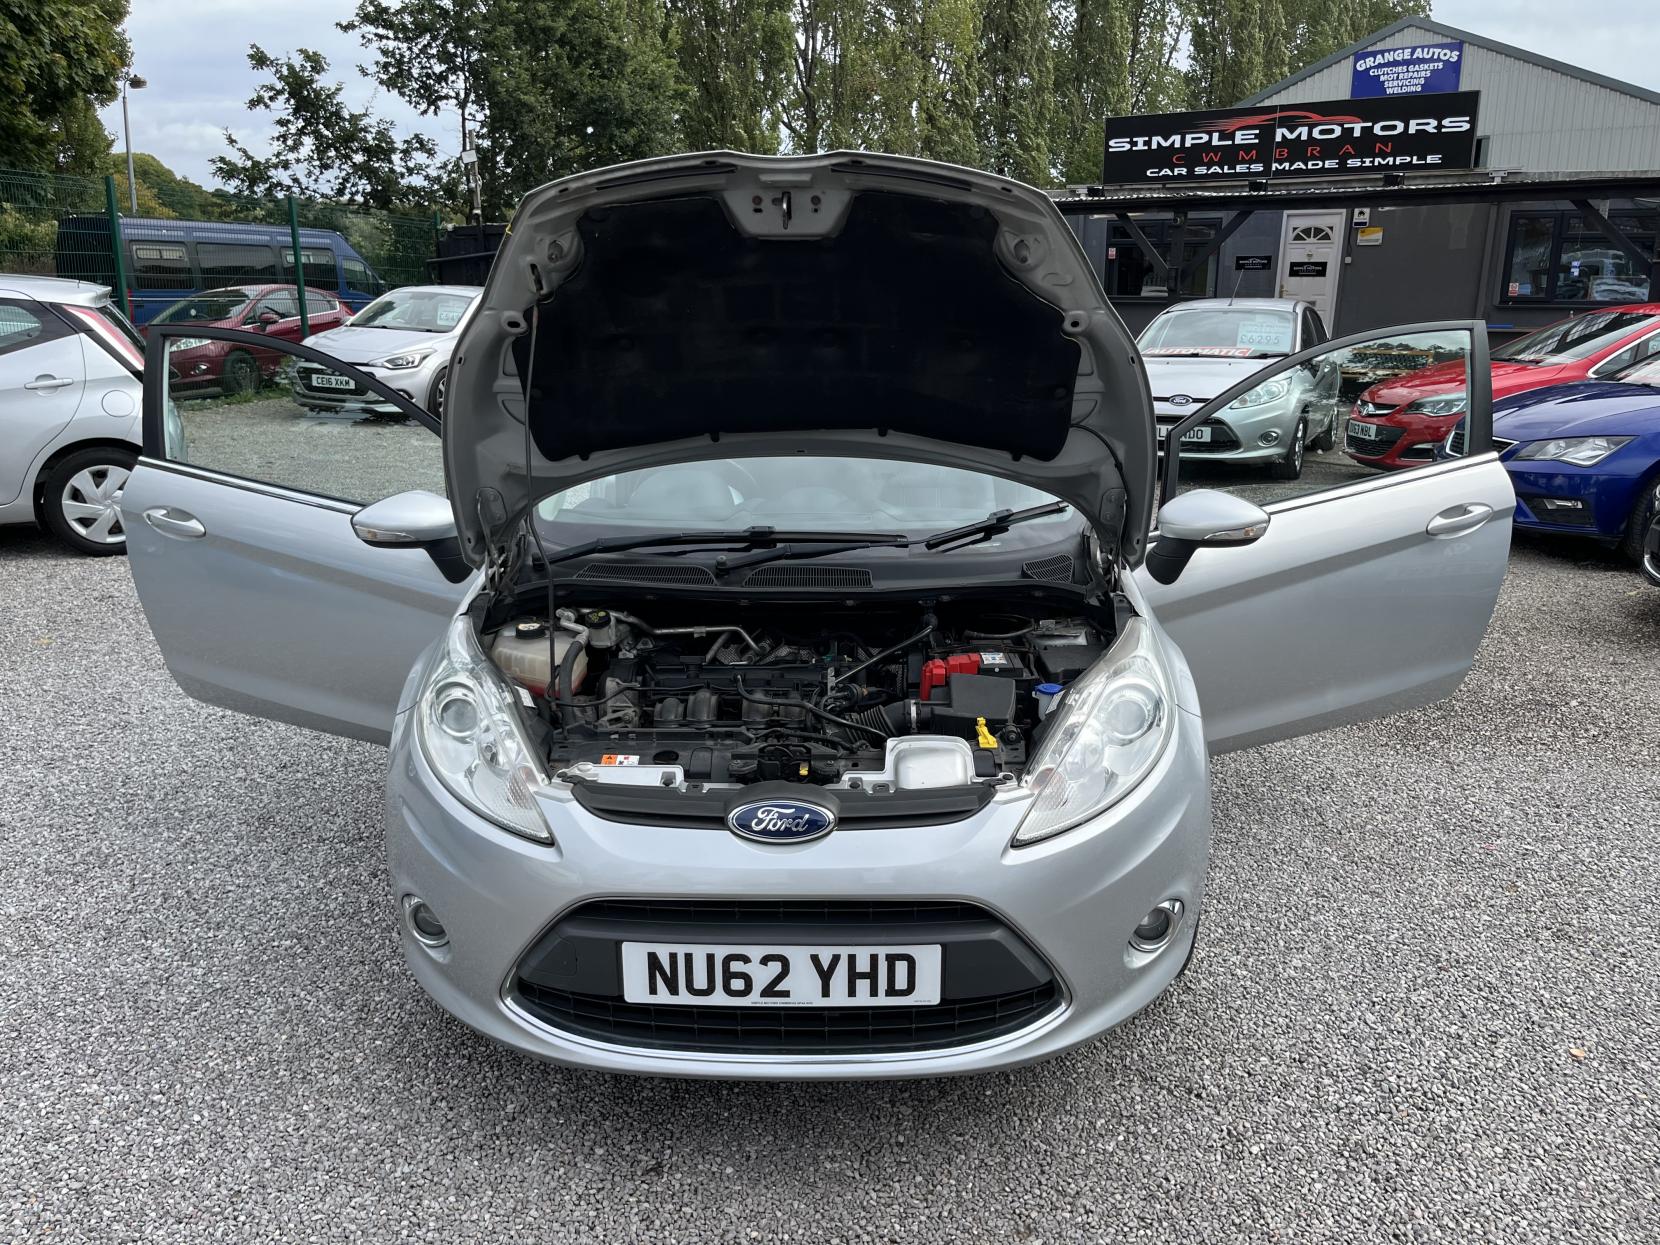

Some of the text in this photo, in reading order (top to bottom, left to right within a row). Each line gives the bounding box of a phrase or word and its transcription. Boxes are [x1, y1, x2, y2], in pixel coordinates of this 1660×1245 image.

[1356, 47, 1460, 71] GRANGE AUTOS
[1369, 62, 1443, 76] CLUTCHES GASKETS
[1379, 70, 1431, 82] MOT REPAIRS
[1384, 77, 1425, 88] SERVICING
[1386, 85, 1422, 95] WELDING
[1108, 116, 1471, 152] SIMPLE MOTORS
[1172, 142, 1393, 164] CWMBRAN
[1146, 154, 1443, 177] CAR SALES MADE SIMPLE
[1150, 347, 1250, 357] AUTOMATIC
[316, 376, 351, 387] CE16 XKM
[751, 806, 810, 832] Ford
[647, 951, 917, 998] NU62 YHD
